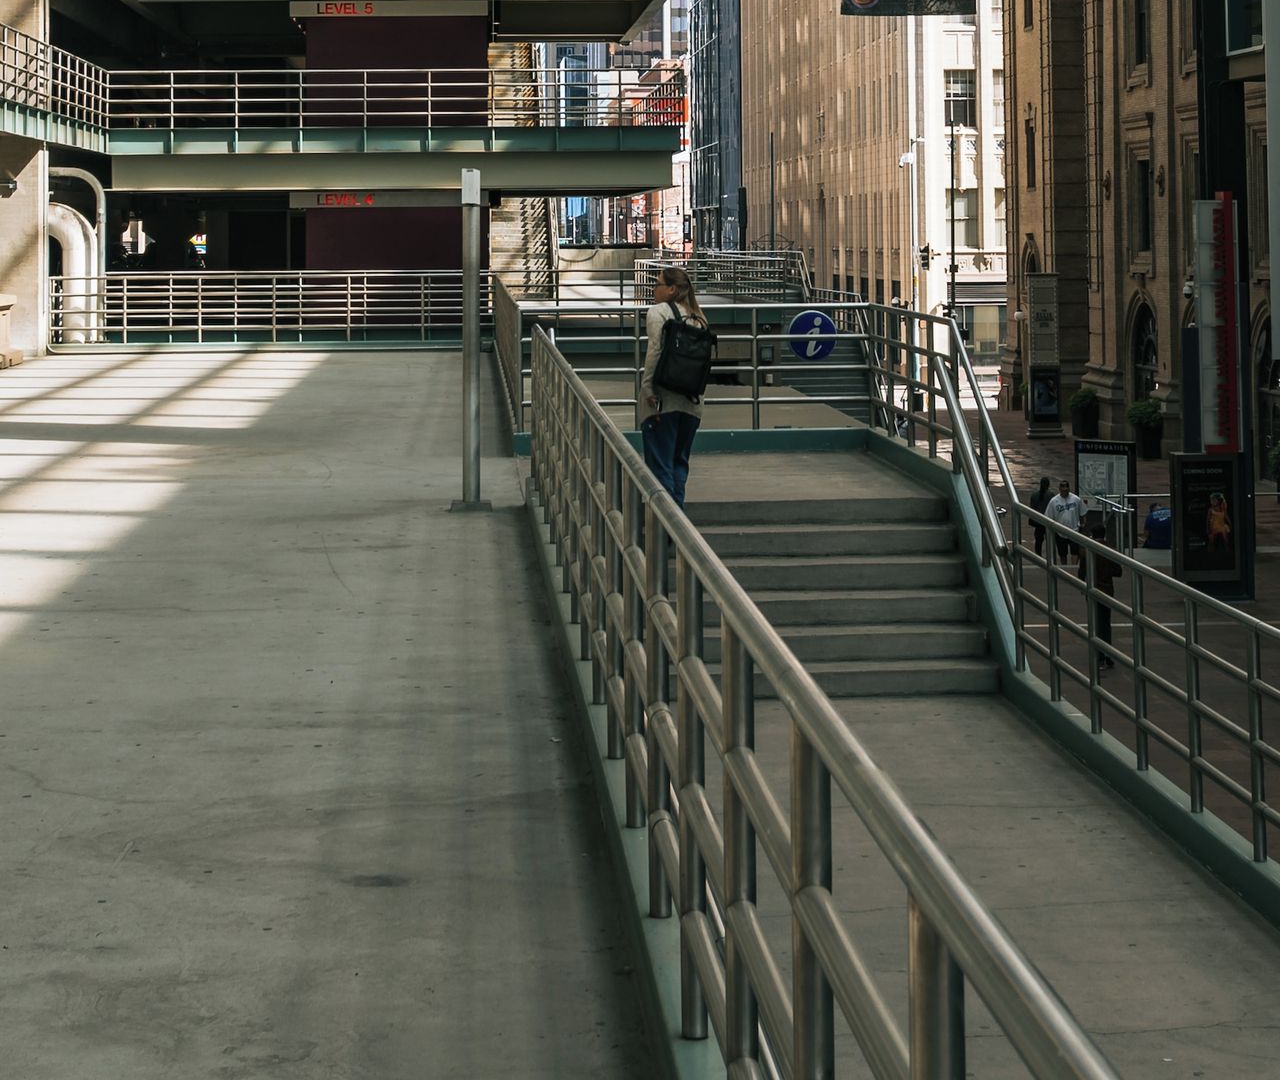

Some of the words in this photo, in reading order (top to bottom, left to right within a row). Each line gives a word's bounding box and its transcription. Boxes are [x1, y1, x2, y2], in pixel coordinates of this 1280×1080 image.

[316, 2, 359, 14] LEVEL
[363, 2, 373, 14] 5
[316, 193, 359, 205] LEVEL
[363, 193, 373, 205] 4
